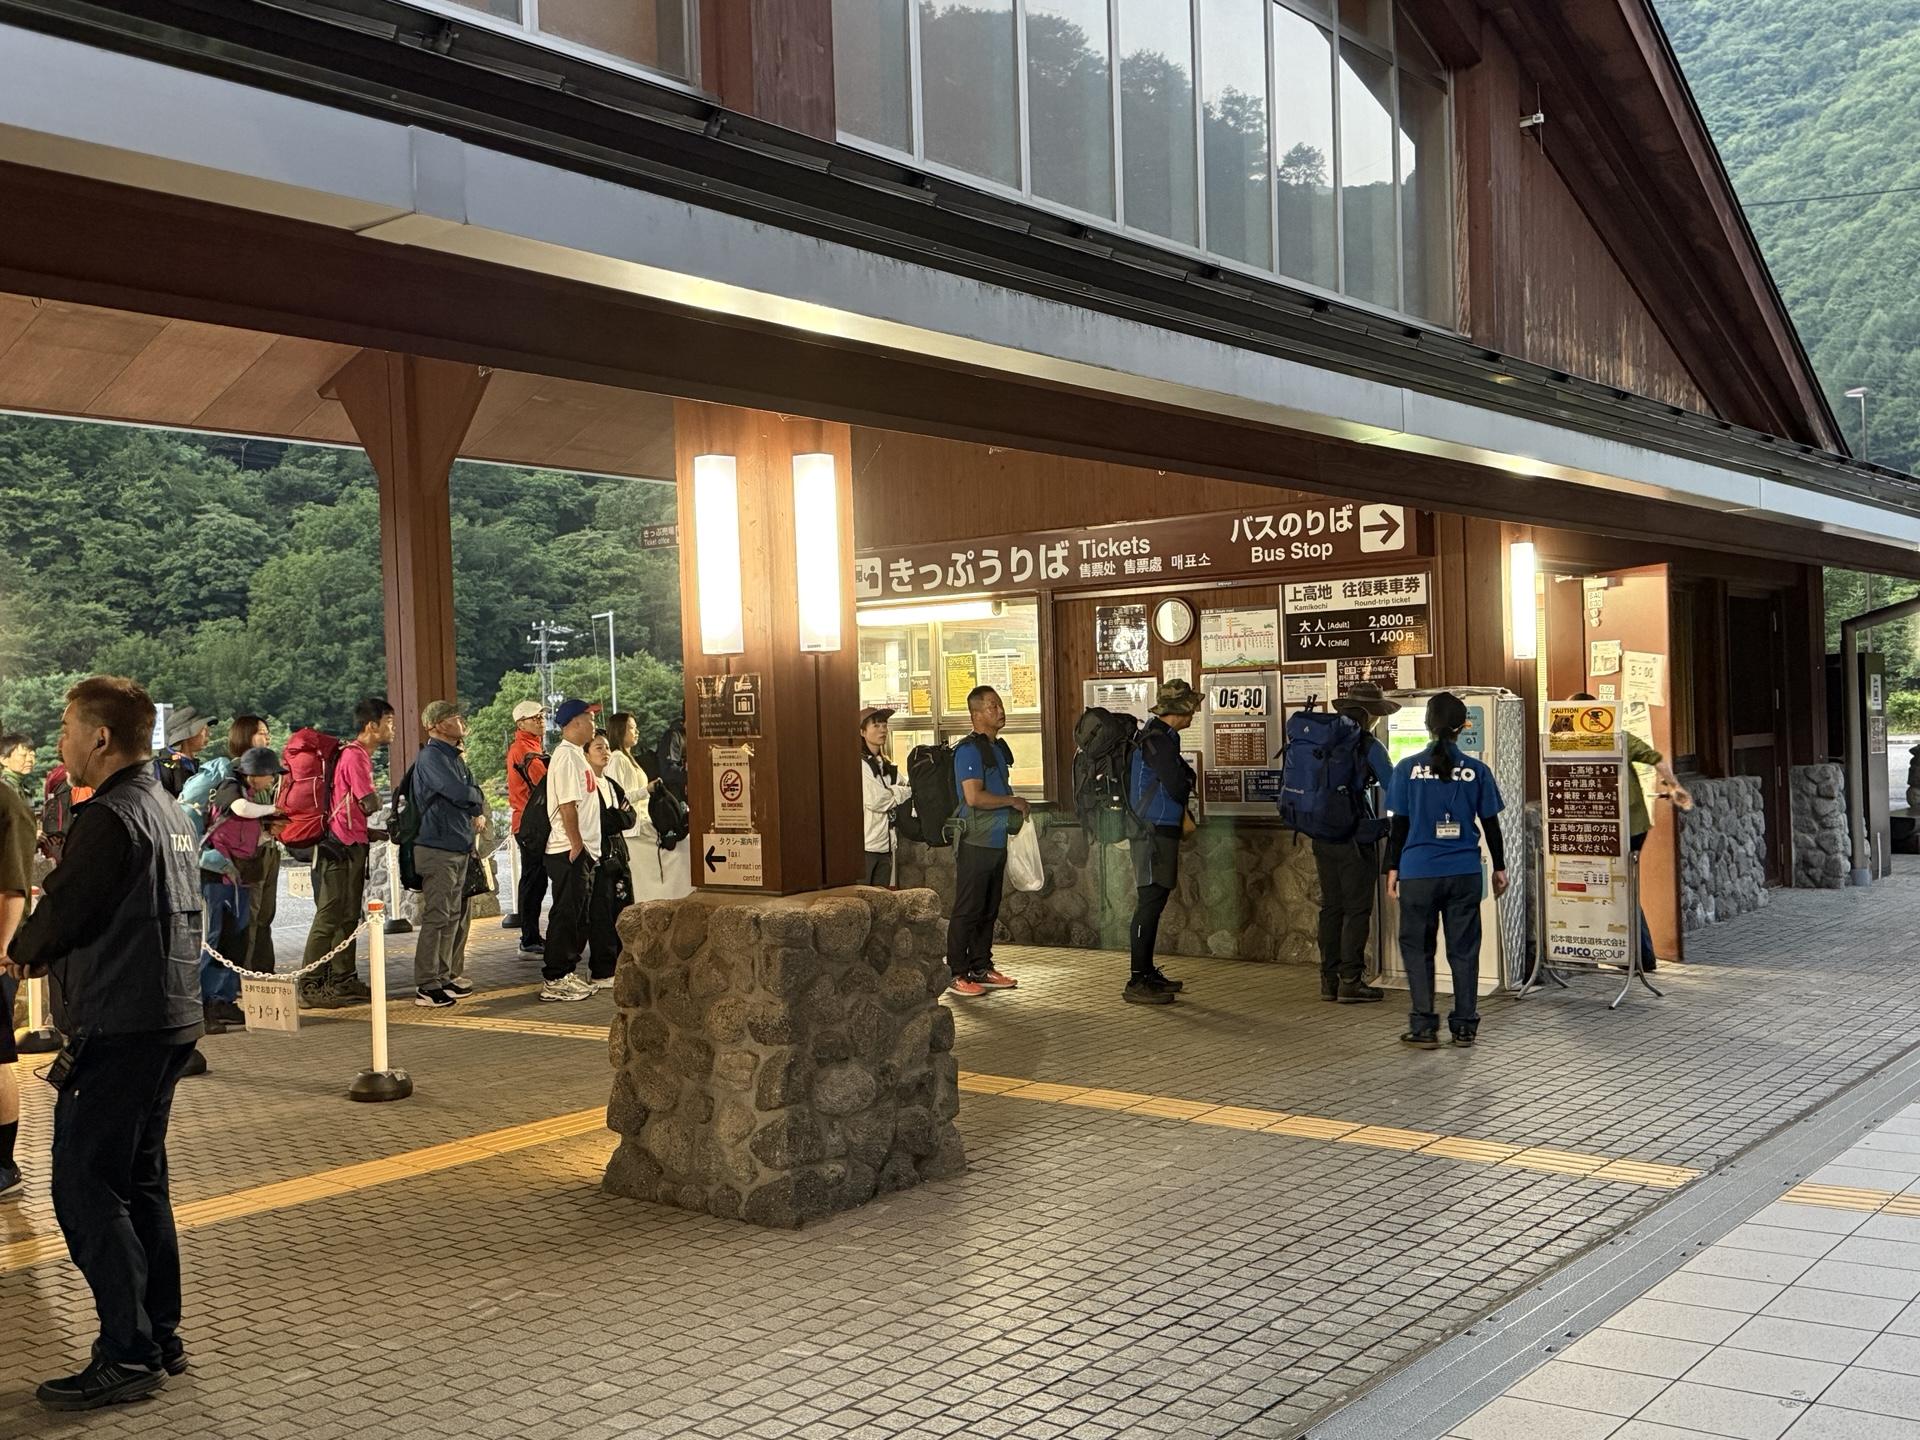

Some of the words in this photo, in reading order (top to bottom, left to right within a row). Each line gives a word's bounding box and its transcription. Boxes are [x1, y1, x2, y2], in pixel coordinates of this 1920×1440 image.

[1230, 504, 1354, 543] バスのりば
[1078, 536, 1150, 560] Tickets
[1251, 546, 1286, 564] Bus
[1290, 541, 1334, 561] Stop
[888, 540, 1070, 593] きっぷうりば
[1079, 562, 1116, 578] 售票处
[1124, 556, 1163, 575] 售票處
[1171, 553, 1212, 570] 매표소
[1288, 584, 1333, 603] 上高地
[1342, 576, 1421, 599] 往復乗車券
[1294, 602, 1329, 612] Kamikochi
[1354, 598, 1390, 608] Round-trip
[1391, 596, 1411, 604] ticket
[1299, 619, 1326, 633] 大人
[1368, 613, 1414, 629] 2,800円
[1300, 634, 1327, 649] 小人
[1369, 629, 1415, 645] 1,400円
[1219, 688, 1263, 708] 05:30
[1410, 765, 1476, 782] ALCO
[1569, 766, 1594, 775] 上高地
[1549, 792, 1554, 800] 7
[1549, 807, 1555, 815] 9
[1551, 823, 1617, 833] 上高地方面の方は
[170, 833, 193, 852] TAXI
[719, 836, 760, 846] タクシー案内所
[1551, 833, 1617, 843] 右手の施設の中へ
[727, 849, 741, 858] Taxi
[1552, 843, 1613, 854] お進みください。
[1553, 945, 1591, 957] ALPICO
[1591, 948, 1626, 959] GROUP
